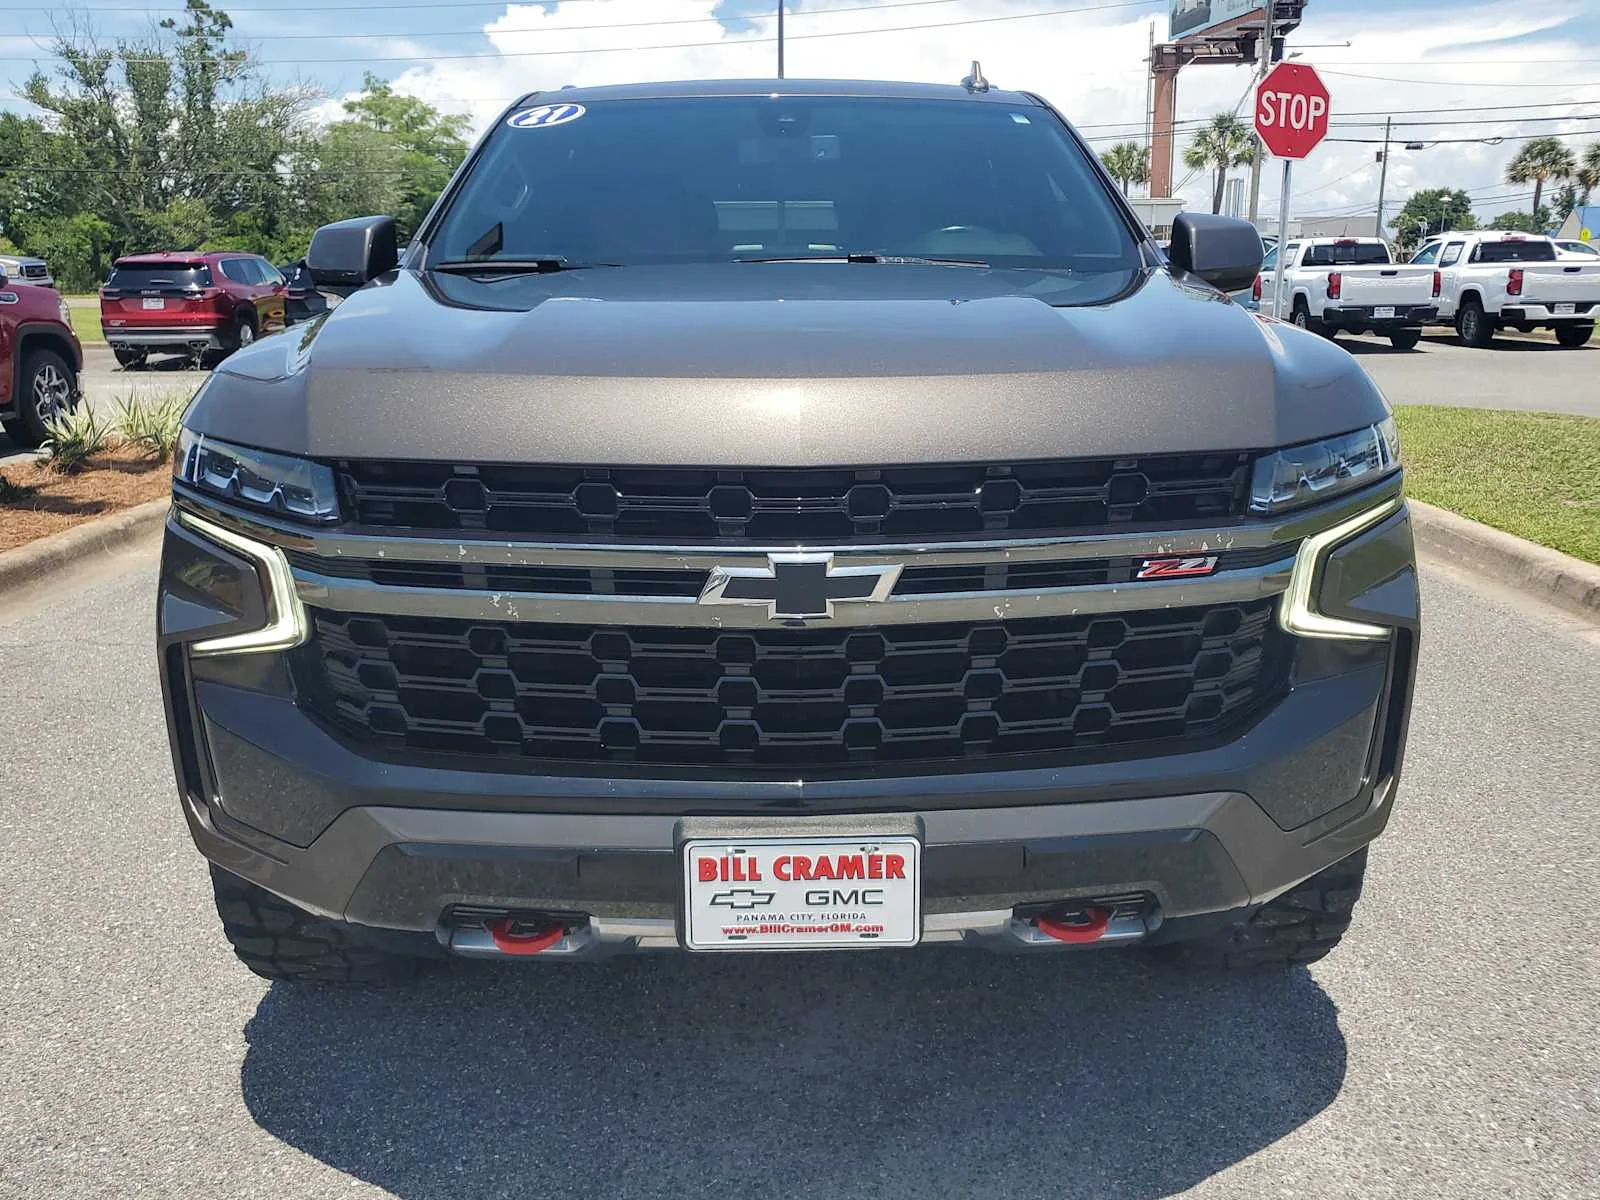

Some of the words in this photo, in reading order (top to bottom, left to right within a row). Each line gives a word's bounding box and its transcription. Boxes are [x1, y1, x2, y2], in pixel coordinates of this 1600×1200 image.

[518, 106, 572, 126] 21
[1259, 90, 1326, 130] STOP
[698, 855, 762, 882] BILL
[772, 854, 906, 881] CRAMER
[805, 889, 884, 905] GMC
[736, 913, 785, 922] PANAMA
[790, 912, 816, 922] CITY,
[820, 912, 867, 921] FLORIDA
[722, 923, 884, 935] www.BillCramerGM.com
